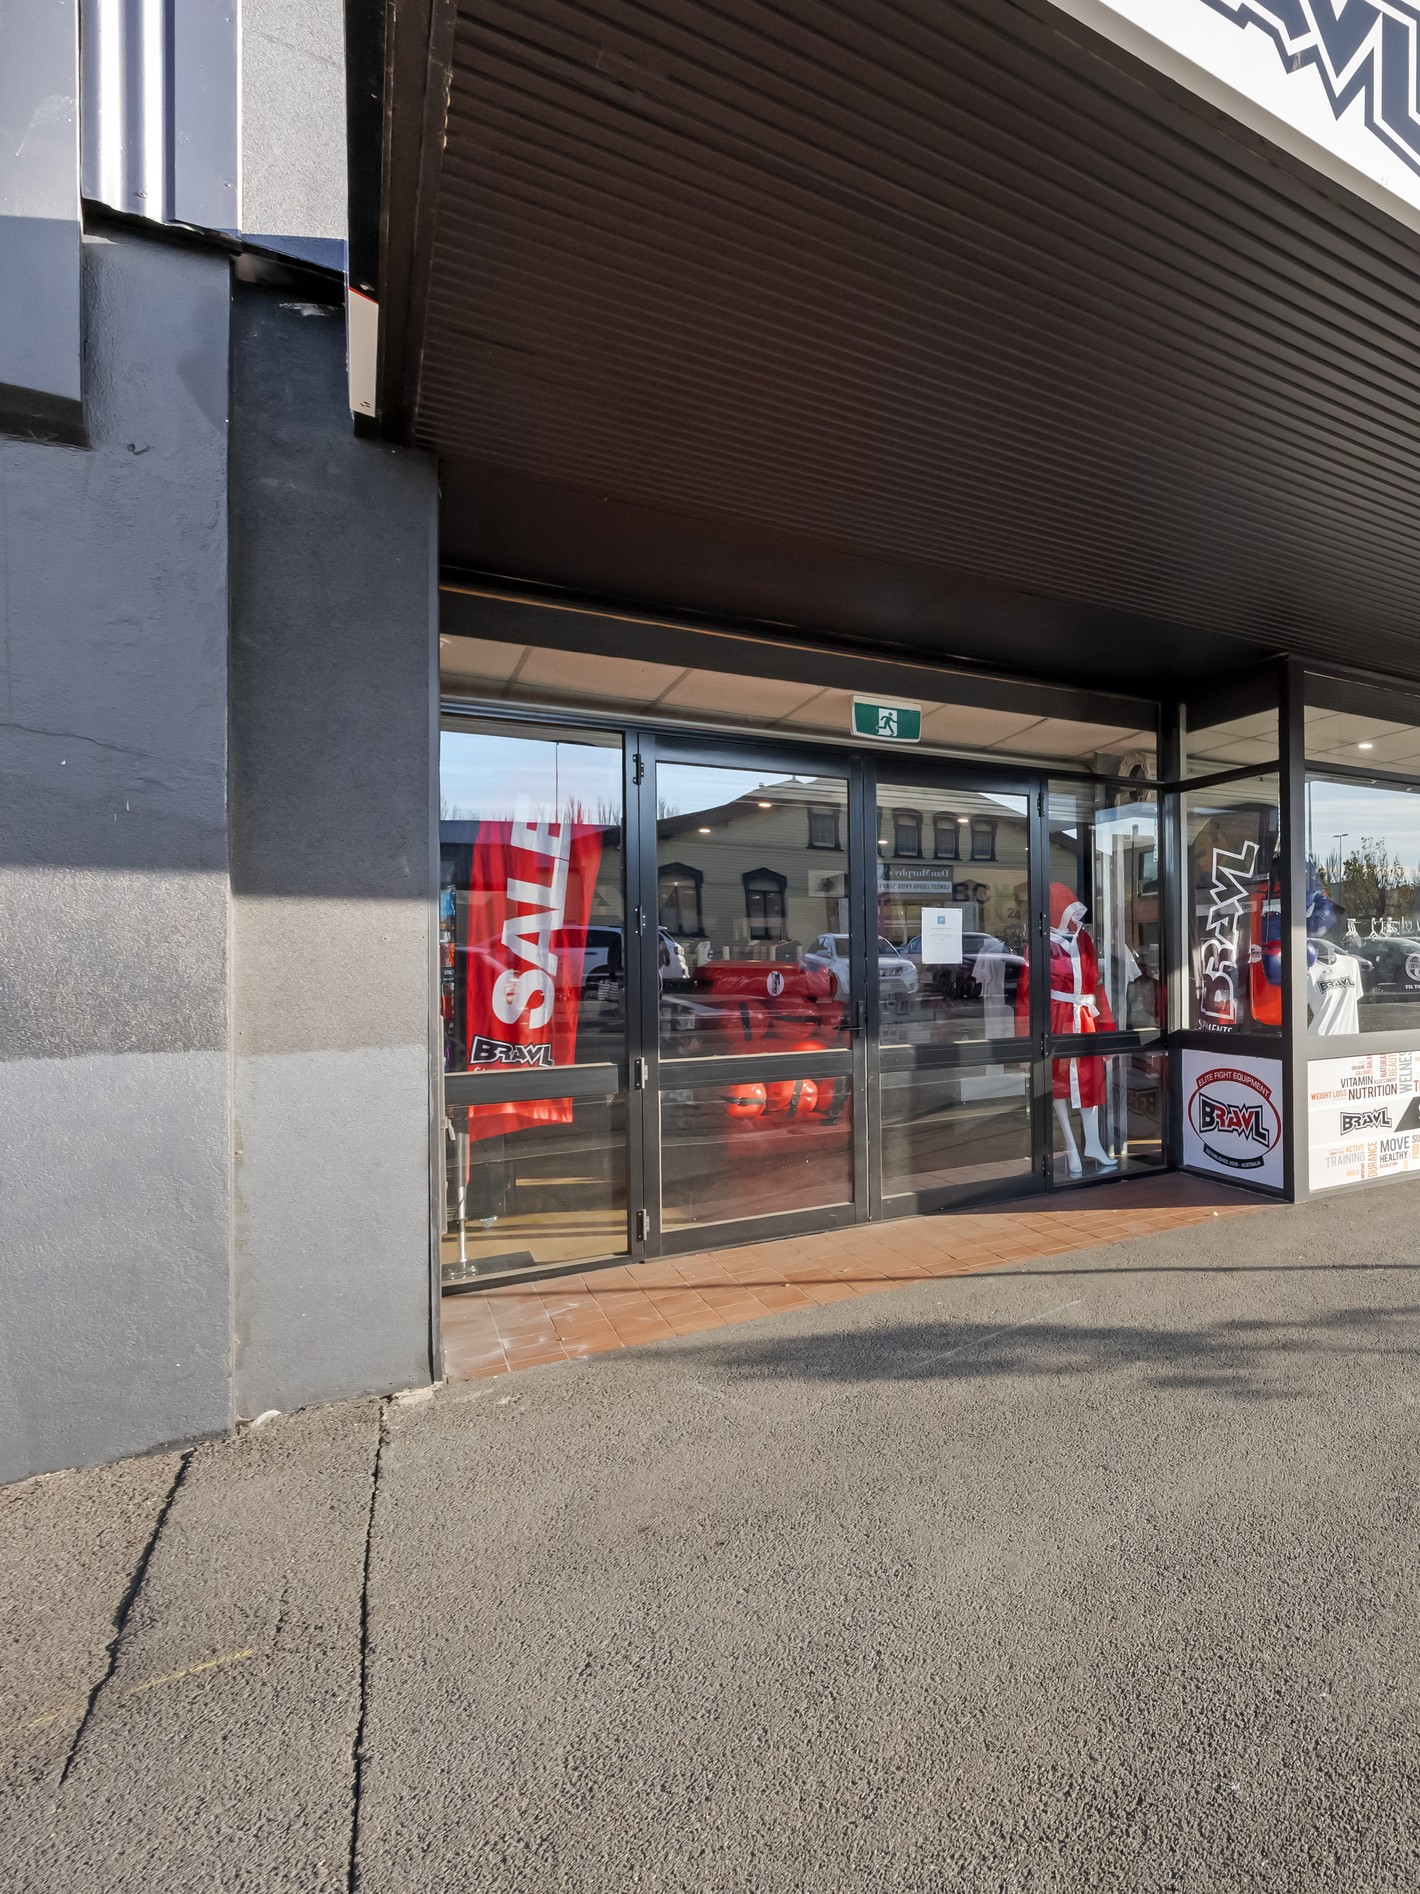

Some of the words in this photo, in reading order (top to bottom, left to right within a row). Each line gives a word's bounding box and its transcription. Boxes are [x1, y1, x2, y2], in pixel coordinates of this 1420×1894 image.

[492, 793, 571, 1029] SALE
[1317, 976, 1355, 994] BRAWL
[470, 1035, 556, 1068] BRAWL
[1198, 1073, 1214, 1086] ELITE
[1214, 1071, 1232, 1079] FIGHT
[1233, 1072, 1270, 1097] EQUIPMENT
[1340, 1075, 1373, 1088] VITAMIN
[1311, 1091, 1332, 1100] WEIGHT
[1333, 1090, 1347, 1098] LOSS
[1348, 1083, 1397, 1101] NUTRITION
[1199, 1092, 1270, 1149] BRAWL
[1340, 1107, 1392, 1136] BRAWL
[1345, 1144, 1364, 1153] ACTIVE
[1380, 1136, 1410, 1153] MOVE
[1412, 1143, 1420, 1160] FOOD
[1325, 1151, 1365, 1168] TRAINING
[1380, 1150, 1408, 1163] HEALTHY
